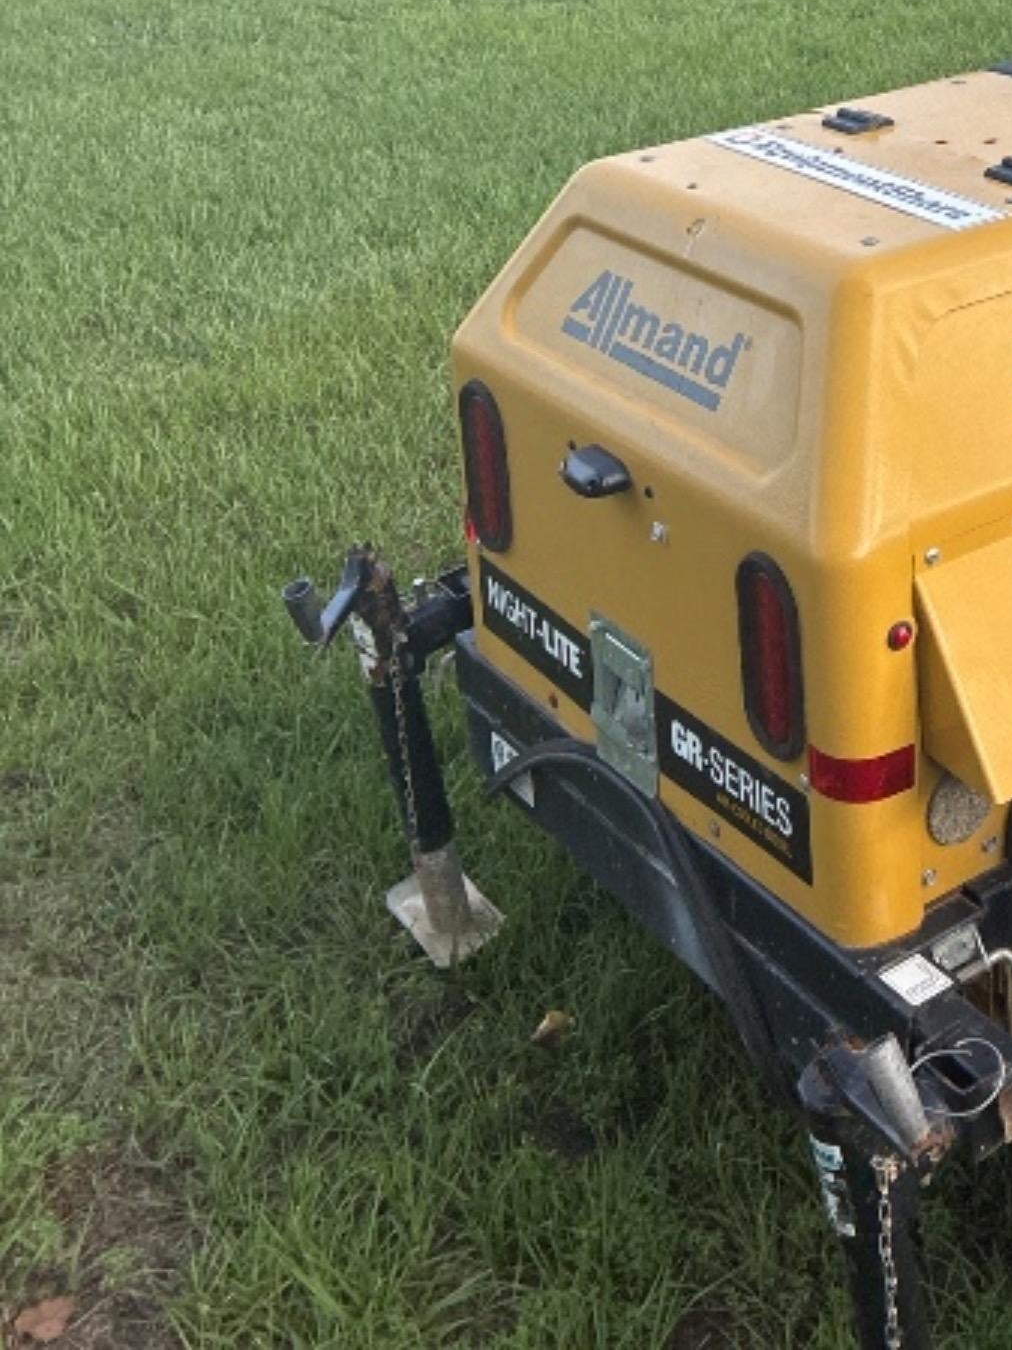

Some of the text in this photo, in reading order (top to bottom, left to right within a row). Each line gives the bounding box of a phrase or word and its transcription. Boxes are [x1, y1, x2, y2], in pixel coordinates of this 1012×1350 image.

[569, 269, 745, 388] Allmand
[487, 574, 583, 679] NIGHT-LITE
[670, 719, 793, 838] GR-SERIES
